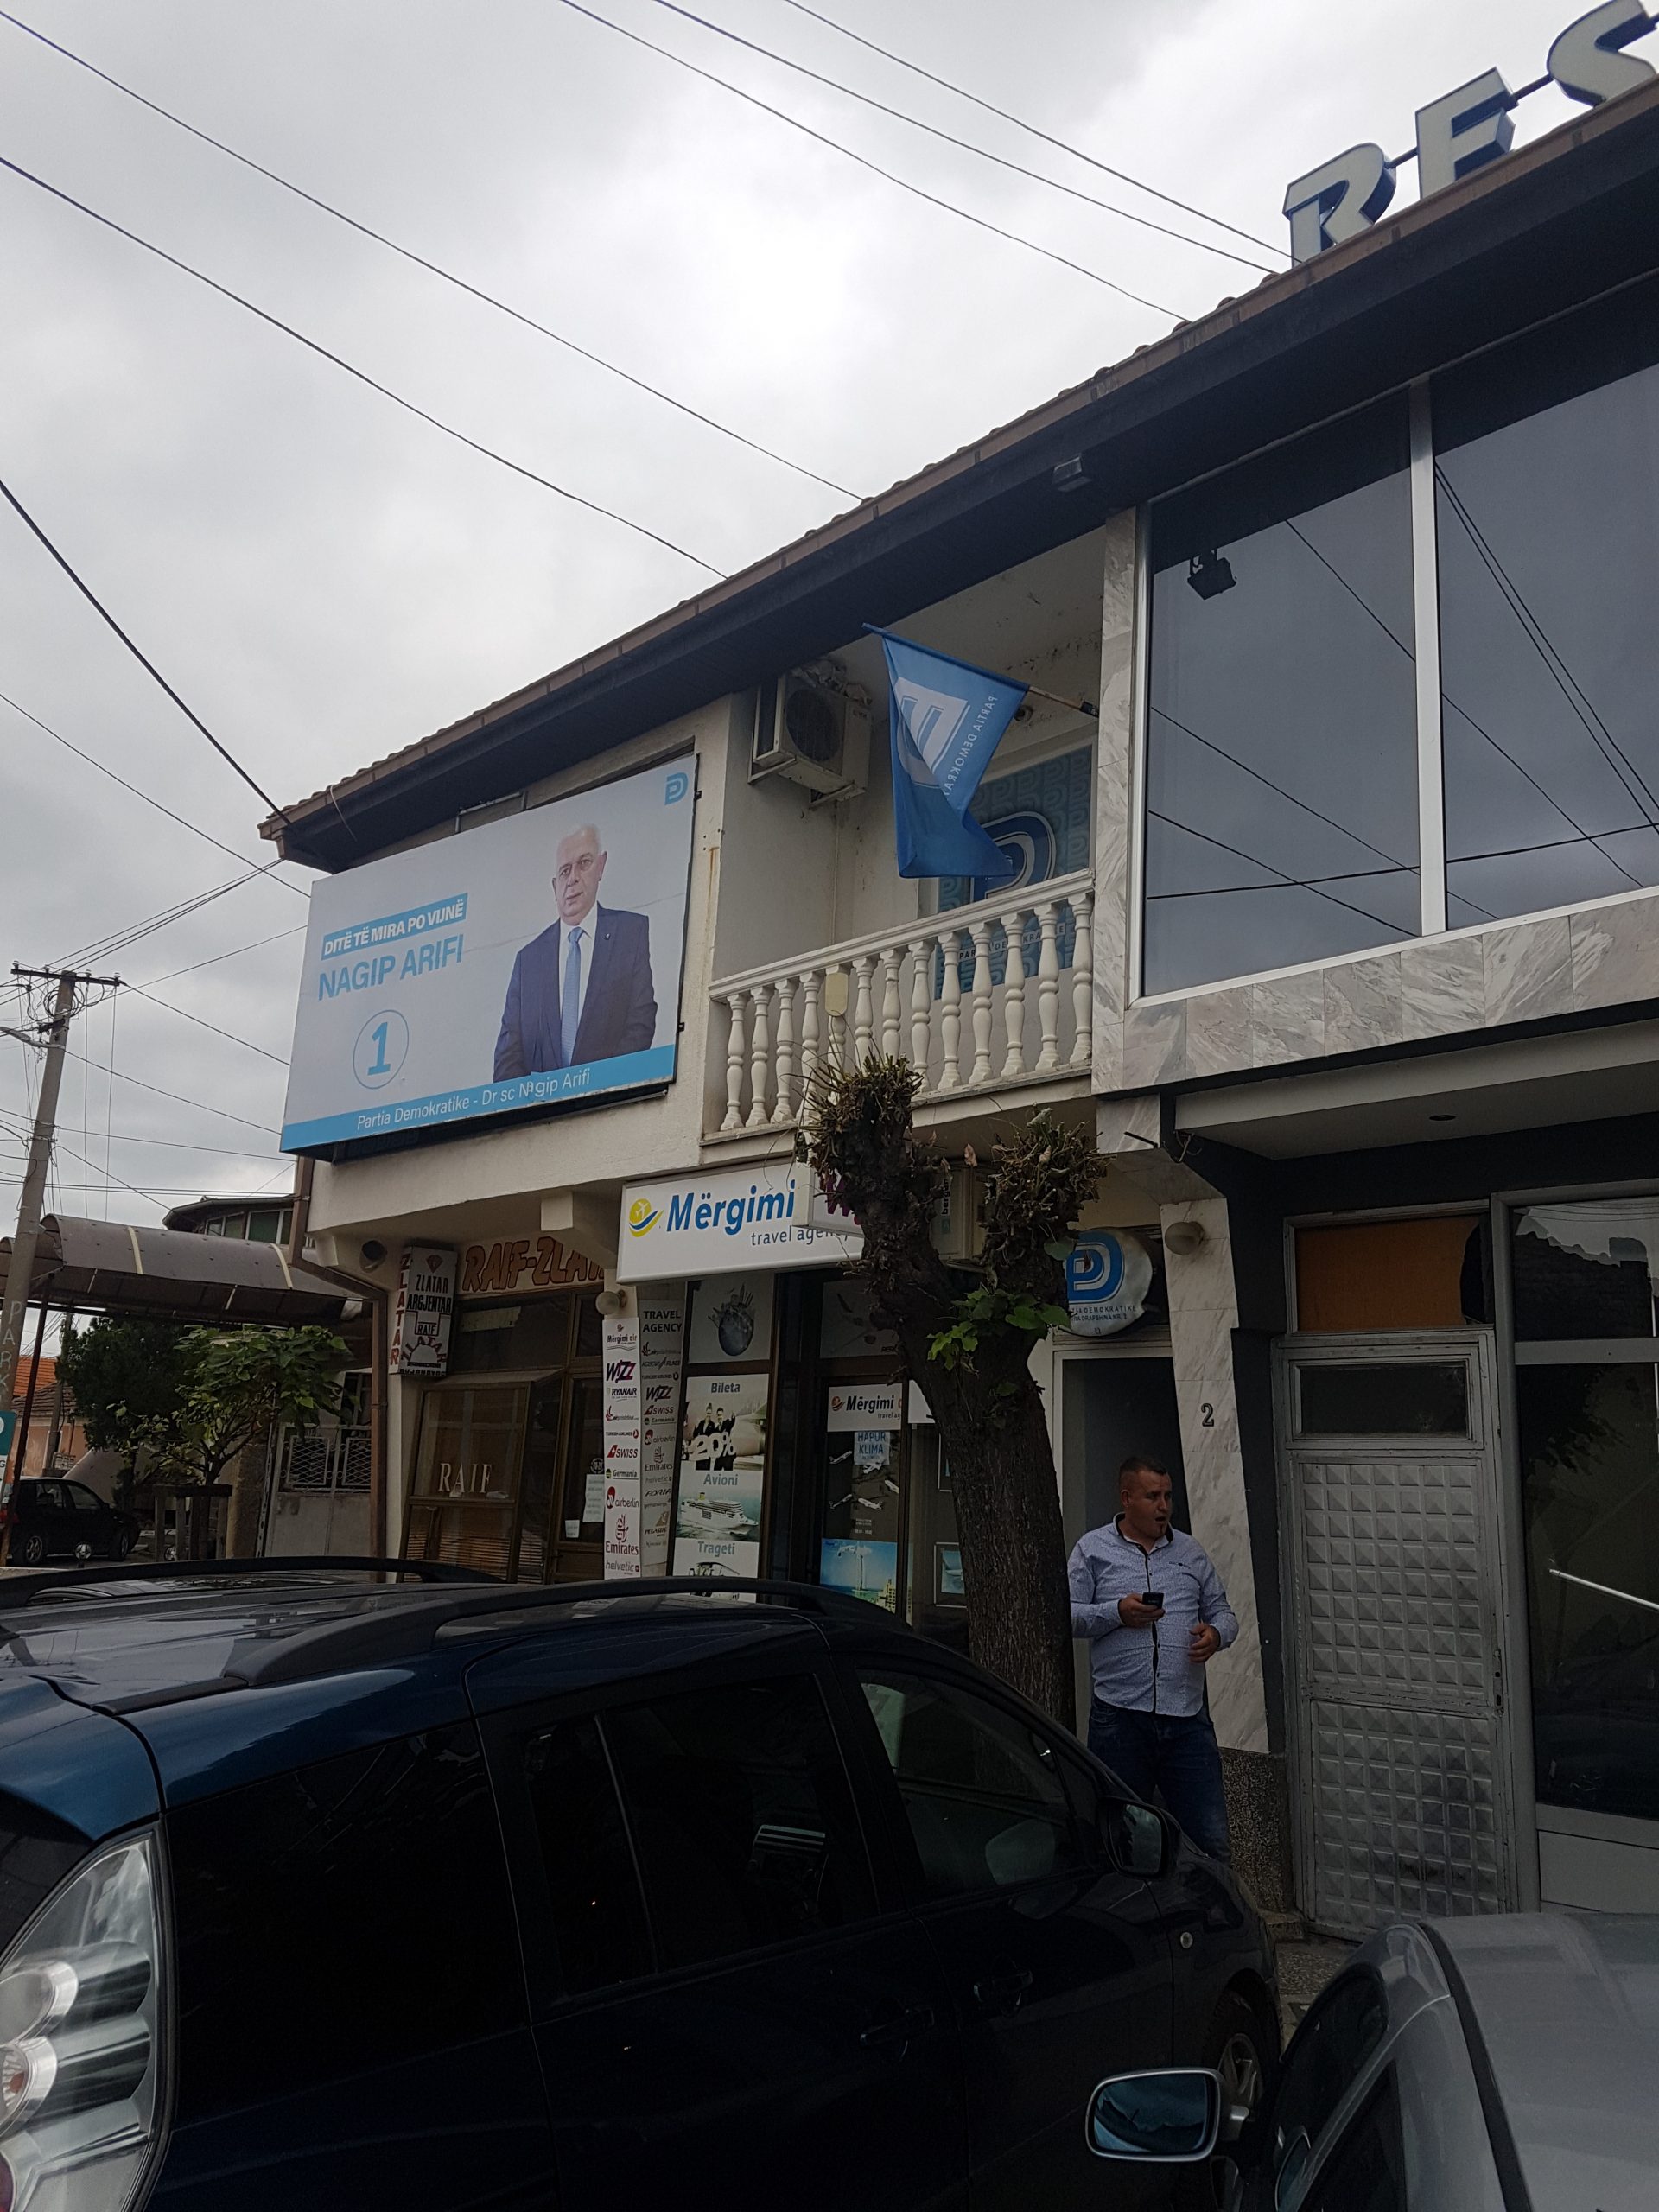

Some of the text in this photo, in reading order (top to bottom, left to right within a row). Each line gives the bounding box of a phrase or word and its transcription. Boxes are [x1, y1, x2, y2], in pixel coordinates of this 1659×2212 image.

[324, 898, 465, 956] DITË TË MIRA PO VIJNË
[318, 933, 465, 1001] NAGIP ARIFI
[366, 1021, 391, 1077] 1
[356, 1110, 391, 1131] Partia
[394, 1095, 469, 1123] Demokratike
[481, 1090, 499, 1106] Dr
[500, 1087, 515, 1101] sc
[562, 1067, 591, 1090] Arifi
[666, 1179, 796, 1236] Mërgimi
[751, 1225, 792, 1246] travel
[415, 1274, 449, 1294] ZLATAR
[390, 1253, 412, 1366] ZLATAR
[406, 1294, 452, 1315] ARGJENTAR
[643, 1310, 681, 1319] TRAVEL
[417, 1324, 436, 1336] RAIF
[642, 1323, 683, 1333] AGENCY
[401, 1336, 448, 1363] ZLATAR
[611, 1388, 638, 1396] RYANAIR
[711, 1382, 741, 1394] Bileta
[652, 1407, 674, 1415] SWISS
[847, 1395, 894, 1414] Mërgimi
[1200, 1402, 1215, 1427] 2
[858, 1432, 886, 1441] HAPUR
[616, 1448, 639, 1459] SWISS
[859, 1444, 884, 1454] KLIMA
[645, 1463, 673, 1471] Emirates
[438, 1462, 493, 1495] RAIF
[703, 1473, 739, 1487] Avioni
[614, 1497, 639, 1508] airberlin
[605, 1541, 639, 1555] Emirates
[697, 1541, 735, 1558] Trageti
[605, 1560, 634, 1573] helvetic
